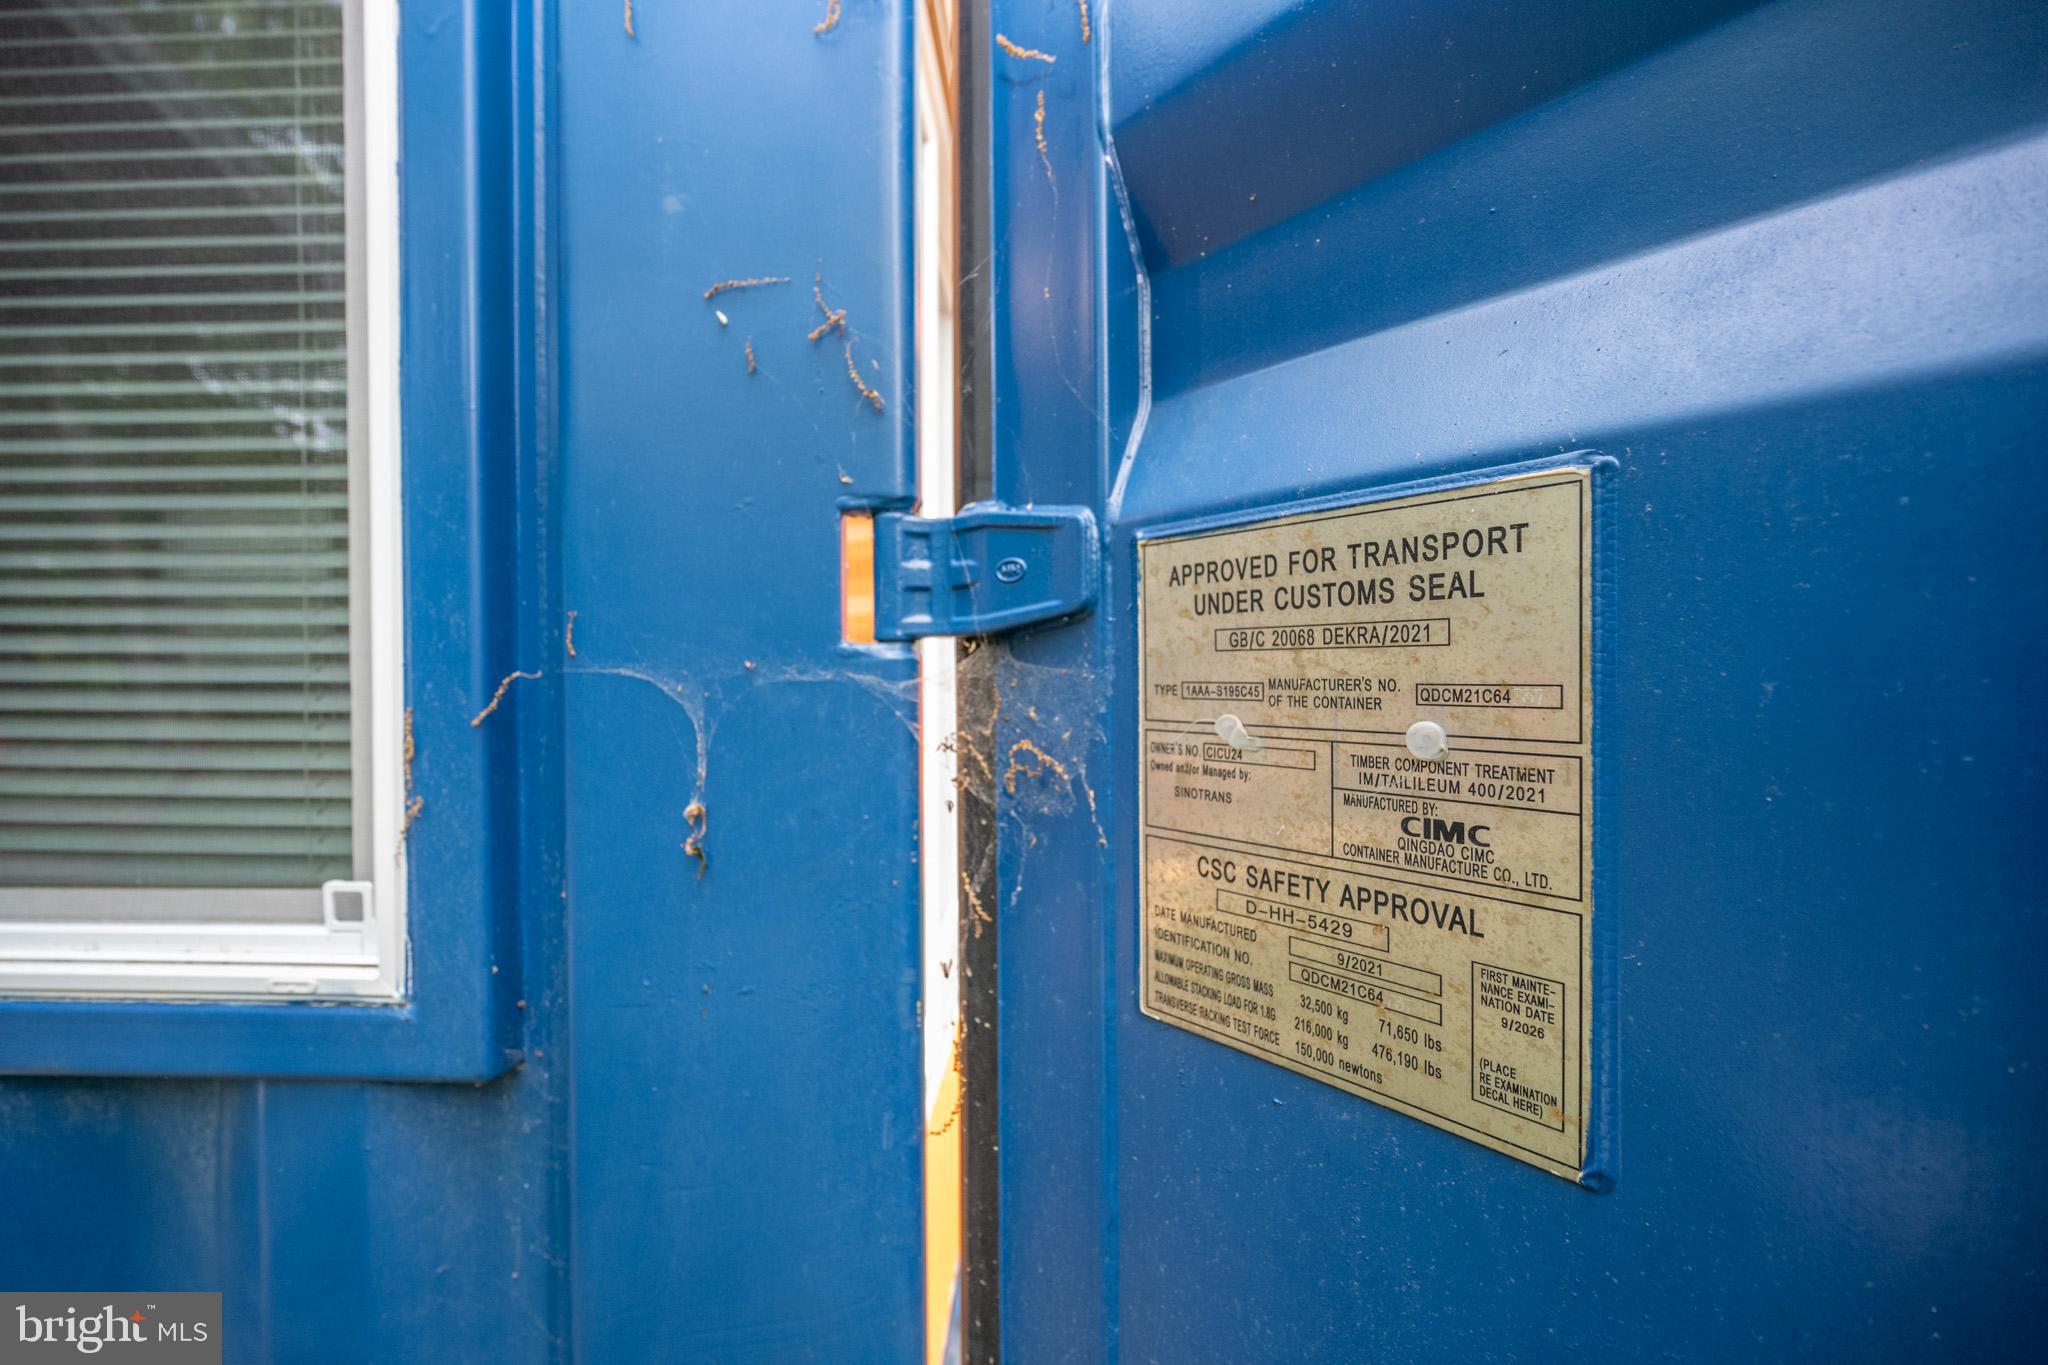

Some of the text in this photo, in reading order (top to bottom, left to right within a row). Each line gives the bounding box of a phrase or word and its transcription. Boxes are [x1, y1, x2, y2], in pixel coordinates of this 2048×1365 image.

[1169, 523, 1529, 587] APPROVED FOR TRANSPORT
[1193, 570, 1485, 616] UNDER CUSTOMS SEAL
[1229, 624, 1431, 648] GB/C 20068 DEKRA/2021
[1154, 684, 1178, 696] TYPE
[1186, 685, 1260, 697] 1AAA-S195C45
[1268, 677, 1401, 692] MANUFACTURER'S NO.
[1420, 688, 1511, 704] QDCM21C64
[1268, 695, 1382, 710] OF THE CONTAINER
[1185, 747, 1201, 758] NO.
[1206, 747, 1243, 760] CICU24
[1150, 760, 1251, 781] Owned and/or Managed by:
[1350, 754, 1555, 785] TIMBER COMPONENT TREATMENT
[1174, 786, 1232, 804] SINOTRANS
[1343, 793, 1438, 817] MANUFACTURED BY:
[1468, 782, 1545, 803] 400/2021
[1400, 816, 1490, 848] CIMC
[1397, 837, 1495, 864] QINGDAO CIMC
[1343, 843, 1552, 890] CONTAINER MANUFACTURE CO., LTD.
[1197, 855, 1484, 937] CSC SAFETY APPROVAL
[1154, 904, 1257, 943] DATE MANUFACTURED
[1246, 900, 1353, 938] D-HH-5429
[1154, 927, 1253, 966] IDENTIFICATION NO.
[1154, 949, 1274, 997] MAXIMUM OPERATING GROSS MASS
[1337, 952, 1383, 977] 9/2021
[1154, 970, 1189, 992] ALLOWABLE
[1191, 981, 1222, 1003] STACKING
[1223, 991, 1242, 1009] LOAD
[1244, 999, 1258, 1014] FOR
[1301, 968, 1384, 1004] QDCM21C64
[1481, 968, 1556, 996] FIRST MAINTE-
[1481, 981, 1555, 1009] NANCE EXAMI-
[1154, 990, 1280, 1046] TRANSVERSE RACKING TEST FORCE
[1300, 994, 1442, 1052] 32,500 kg 71,650 lbs
[1481, 995, 1555, 1025] NATION DATE
[1501, 1017, 1545, 1040] 9/2026
[1294, 1017, 1442, 1079] 216,000 kg 476,190 lbs
[1295, 1041, 1383, 1084] 150,000 newtons
[1480, 1057, 1516, 1080] (PLACE
[1480, 1072, 1557, 1107] RE EXAMINATION
[1480, 1085, 1543, 1119] DECAL HERE)
